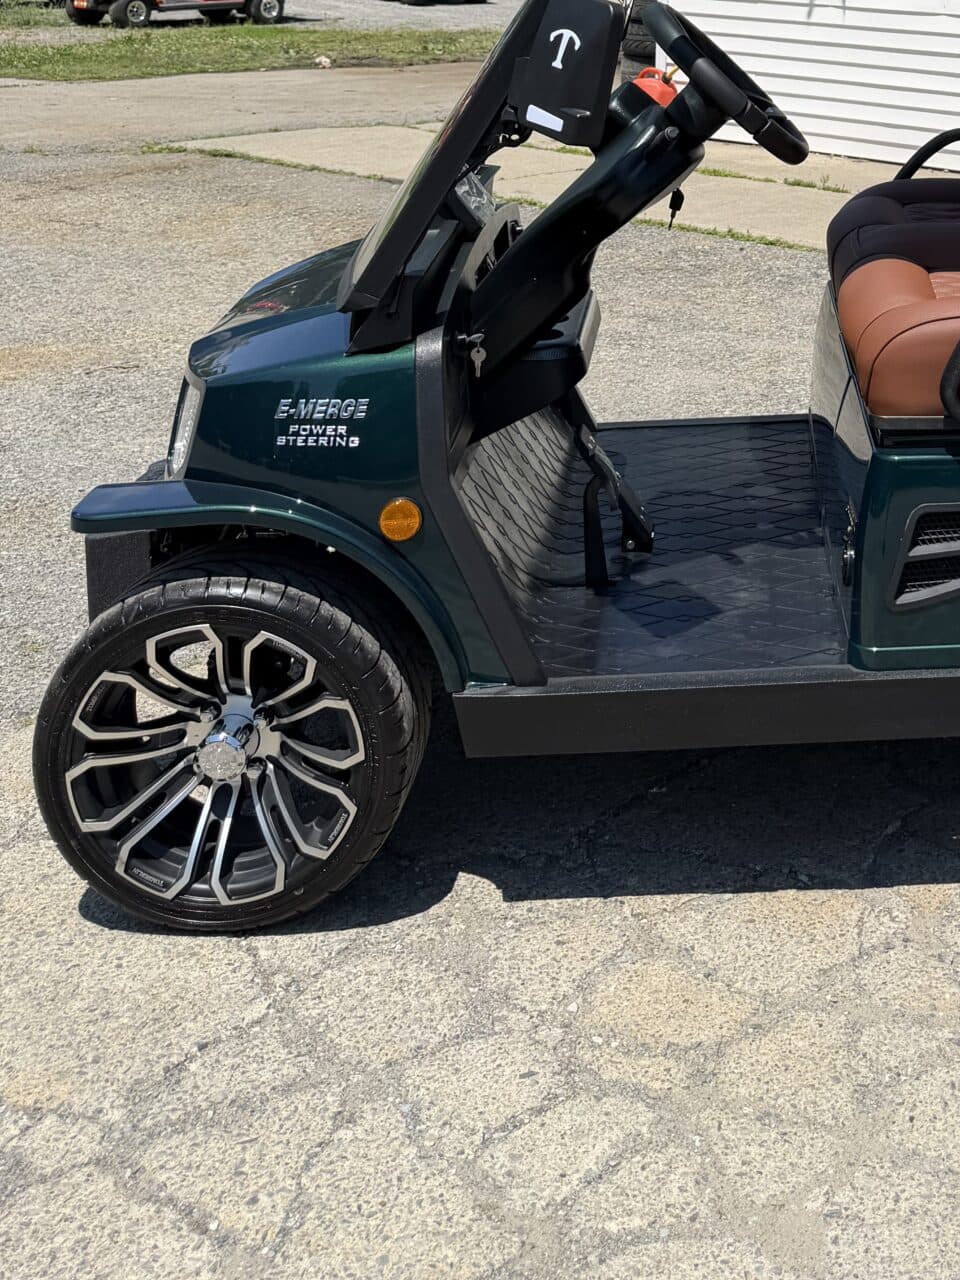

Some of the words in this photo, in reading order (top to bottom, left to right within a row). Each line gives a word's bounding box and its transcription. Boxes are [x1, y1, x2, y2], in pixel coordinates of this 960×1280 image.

[274, 398, 370, 419] E-MERGE
[289, 425, 347, 435] POWER
[276, 436, 360, 447] STEERING
